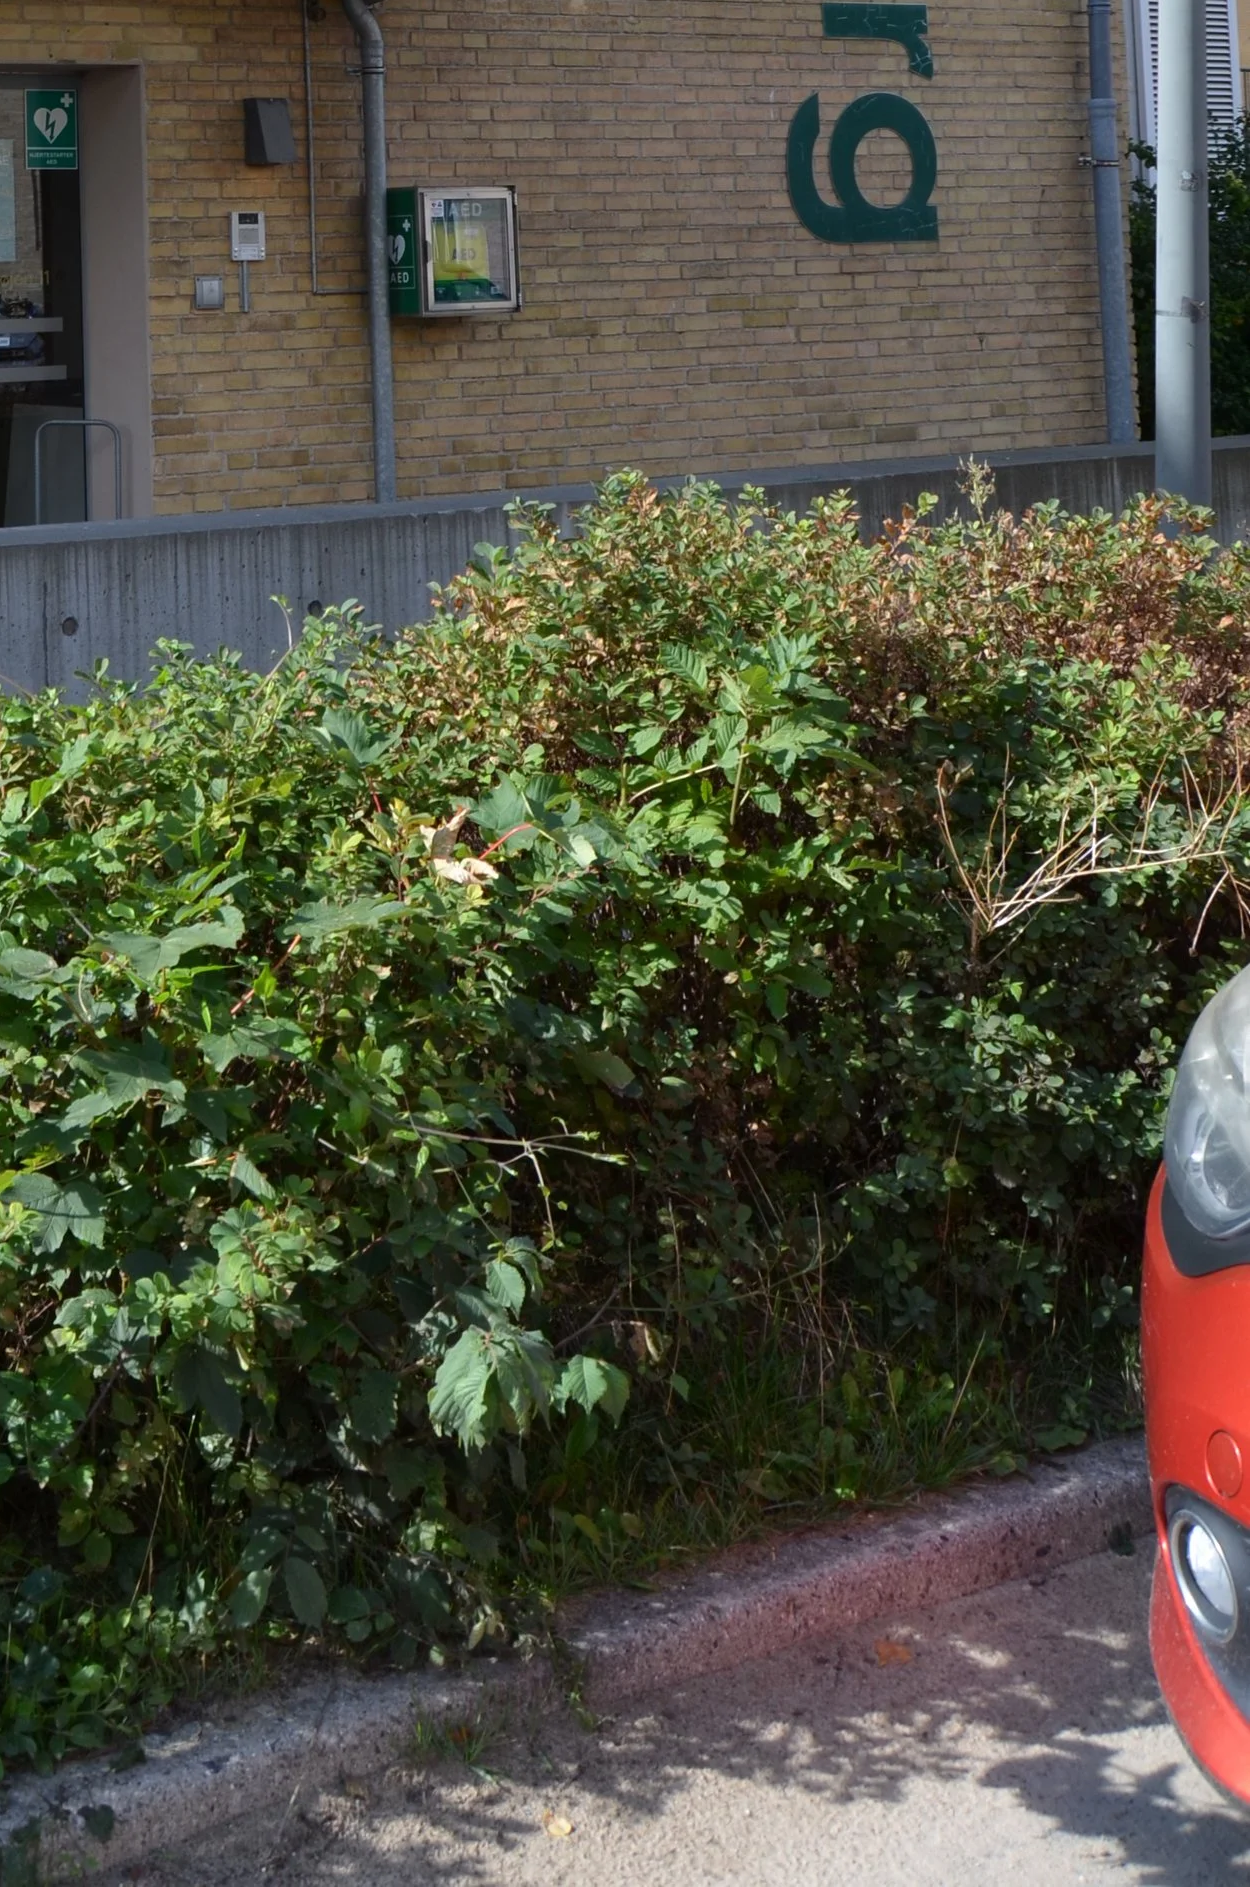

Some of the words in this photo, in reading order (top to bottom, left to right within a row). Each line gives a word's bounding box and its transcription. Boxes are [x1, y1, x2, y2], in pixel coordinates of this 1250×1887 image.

[29, 151, 74, 159] HJERTESTARTER
[449, 202, 483, 217] AED
[452, 247, 477, 261] AED
[389, 271, 410, 284] AED
